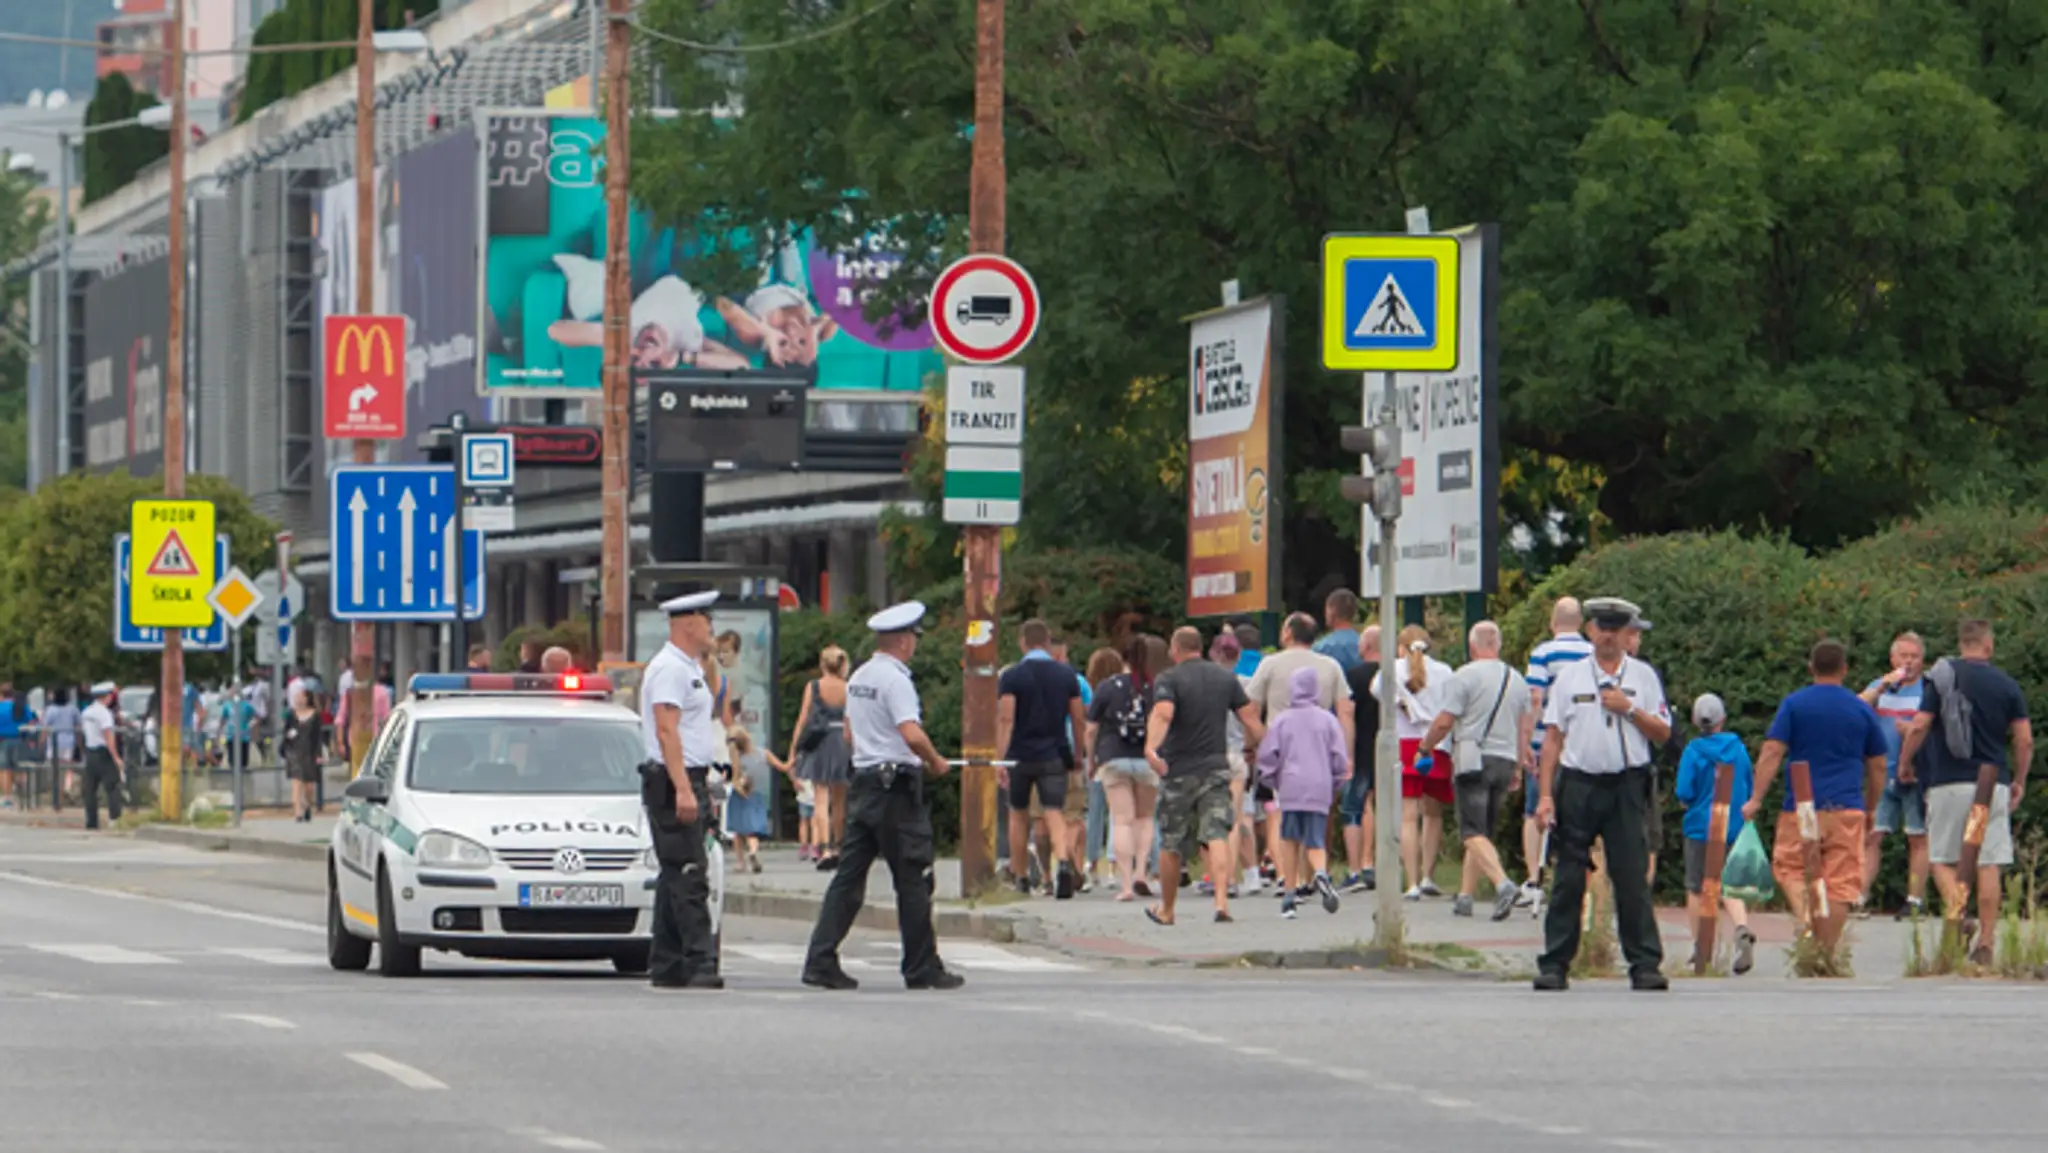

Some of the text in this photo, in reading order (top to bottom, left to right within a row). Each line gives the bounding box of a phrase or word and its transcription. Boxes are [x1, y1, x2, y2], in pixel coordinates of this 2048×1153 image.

[971, 381, 995, 399] TIR
[951, 412, 1016, 430] TRANZIT
[150, 507, 195, 522] POZOR
[152, 585, 193, 601] ŠKOLA
